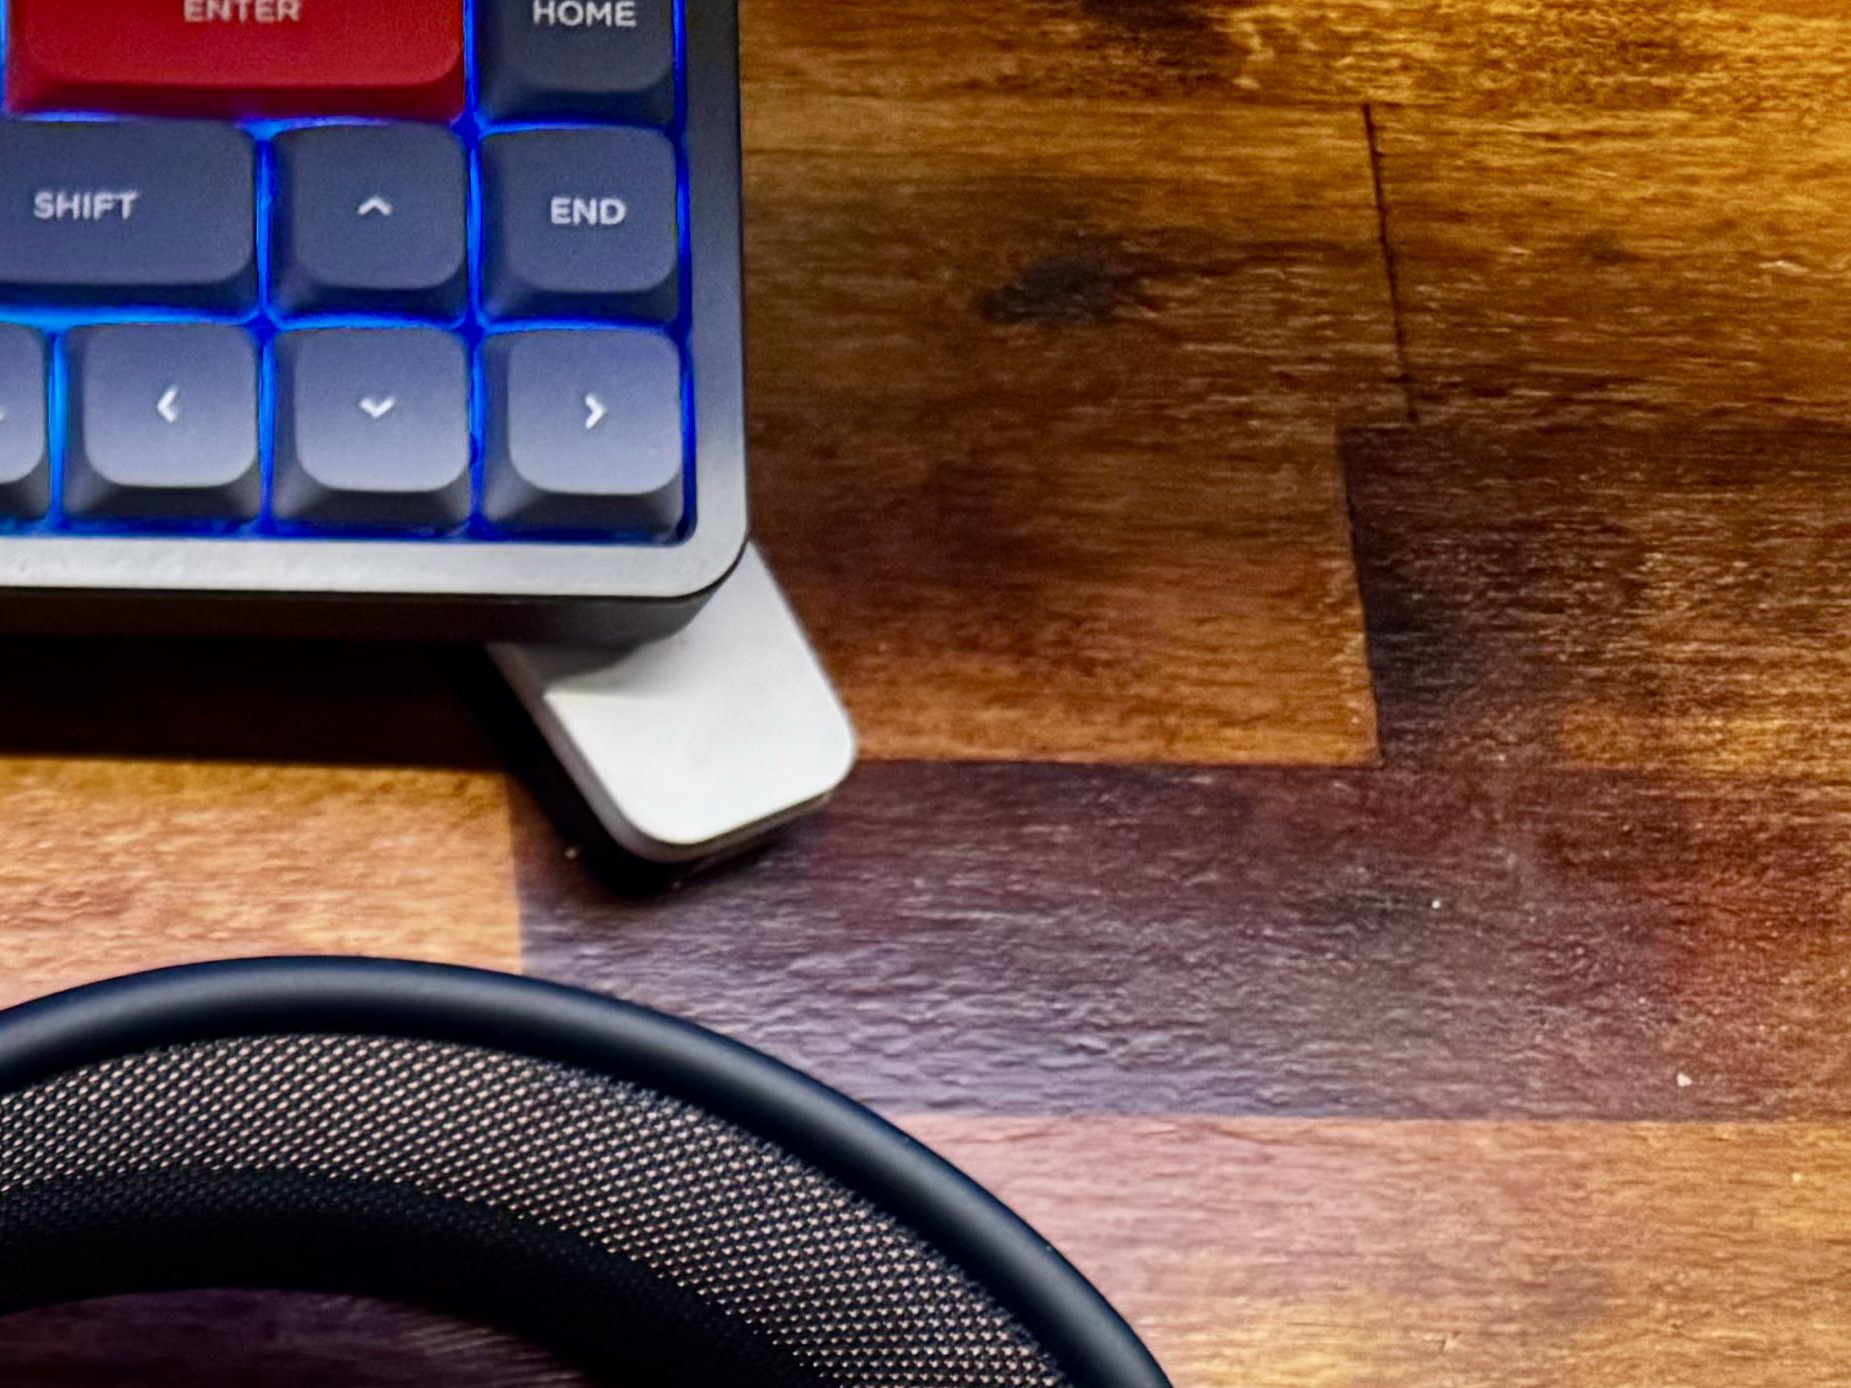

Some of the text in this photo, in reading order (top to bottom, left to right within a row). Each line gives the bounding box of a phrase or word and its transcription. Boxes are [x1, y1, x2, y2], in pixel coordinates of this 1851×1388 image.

[184, 0, 301, 22] ENTER
[533, 0, 636, 27] HOME
[34, 190, 138, 219] SHIFT
[551, 197, 627, 225] END
